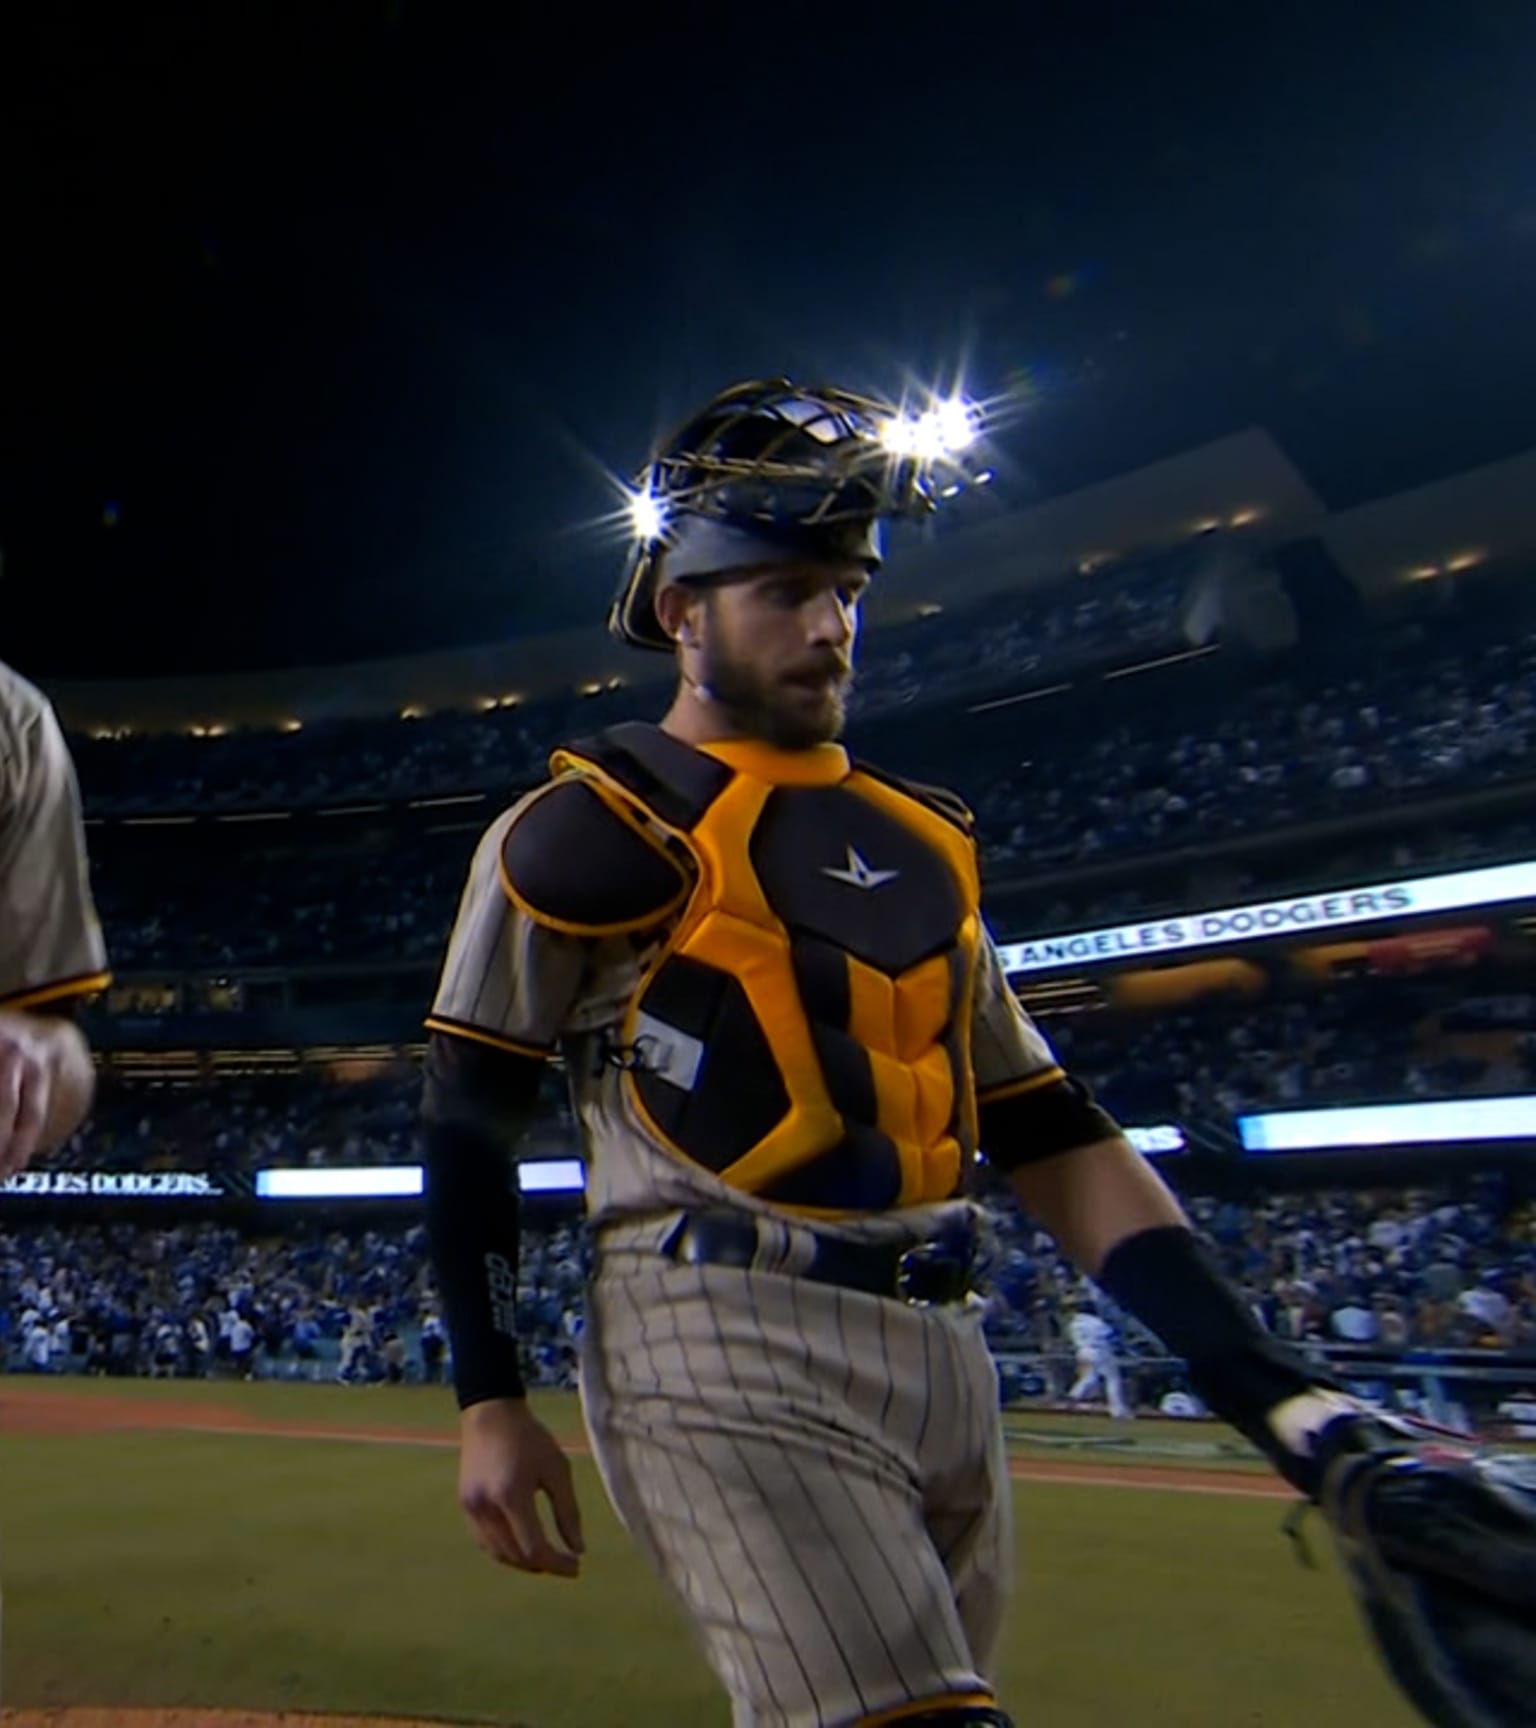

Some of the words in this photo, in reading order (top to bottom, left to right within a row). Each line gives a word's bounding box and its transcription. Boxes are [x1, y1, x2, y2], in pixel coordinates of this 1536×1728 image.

[1021, 922, 1185, 964] ANGELES
[1201, 887, 1412, 938] DODGERS
[91, 1172, 209, 1195] DODGERS
